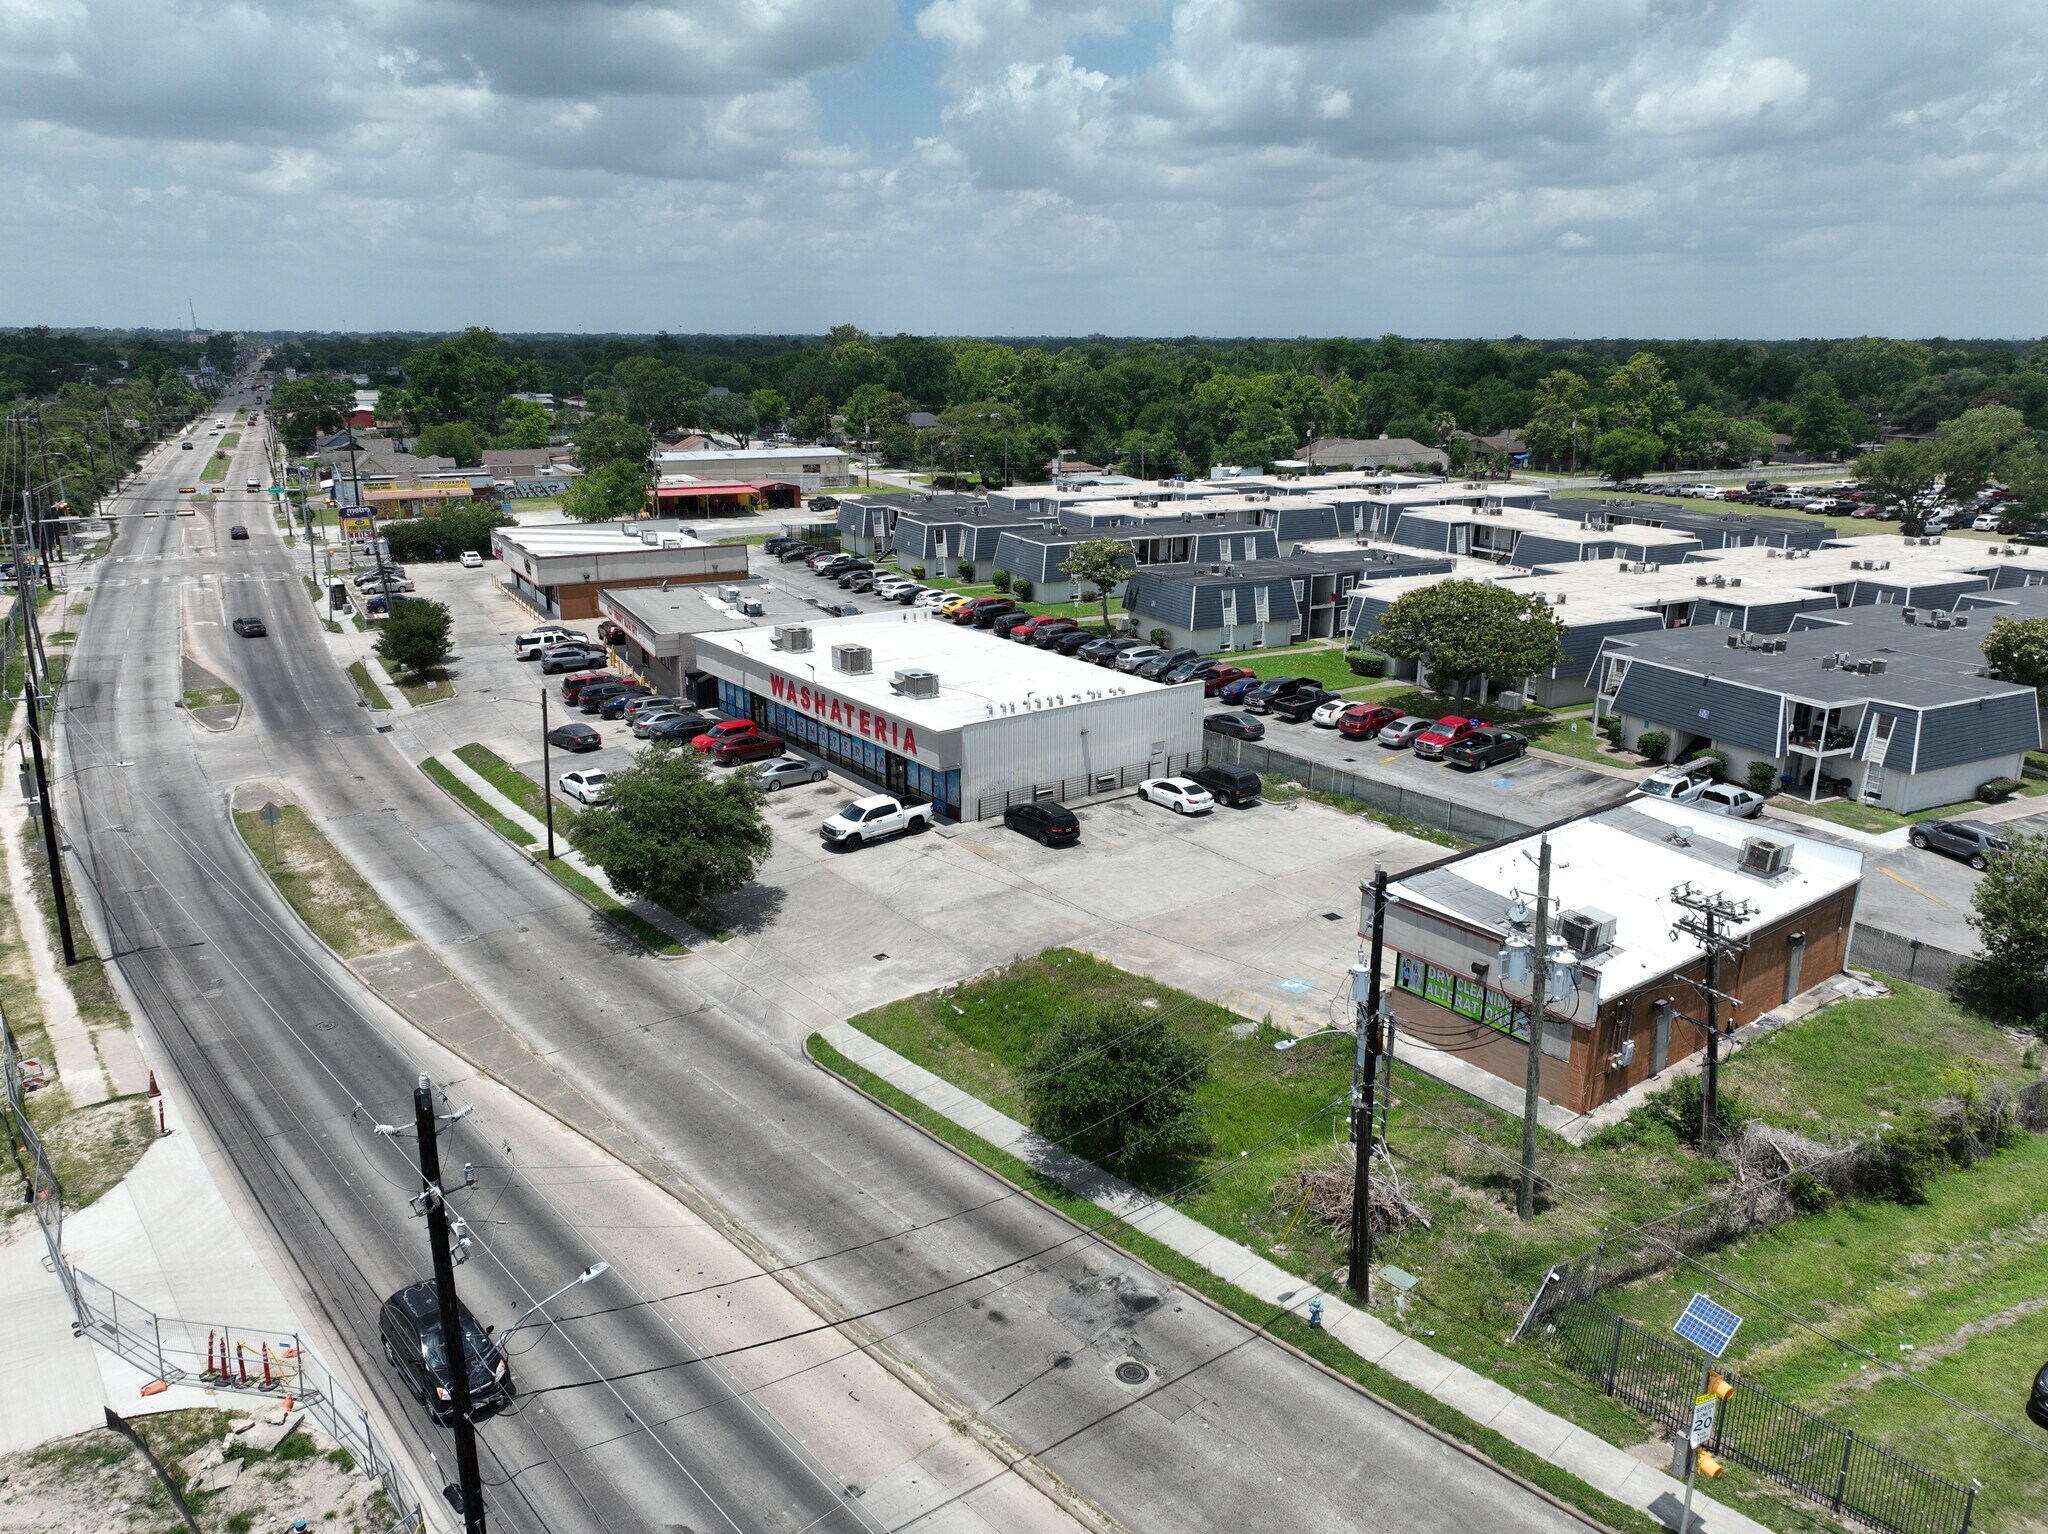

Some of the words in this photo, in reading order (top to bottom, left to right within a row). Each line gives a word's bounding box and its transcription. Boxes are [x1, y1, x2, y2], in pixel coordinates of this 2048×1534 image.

[770, 672, 918, 756] WASHATERIA
[777, 711, 886, 772] WASHATERIA
[1426, 982, 1512, 1028] ALTERATIONS
[1427, 966, 1454, 987] DRY
[1456, 977, 1513, 1011] CLEANING
[1693, 1416, 1713, 1432] 20
[1696, 1402, 1715, 1413] SPEED
[1696, 1410, 1713, 1419] LIMIT
